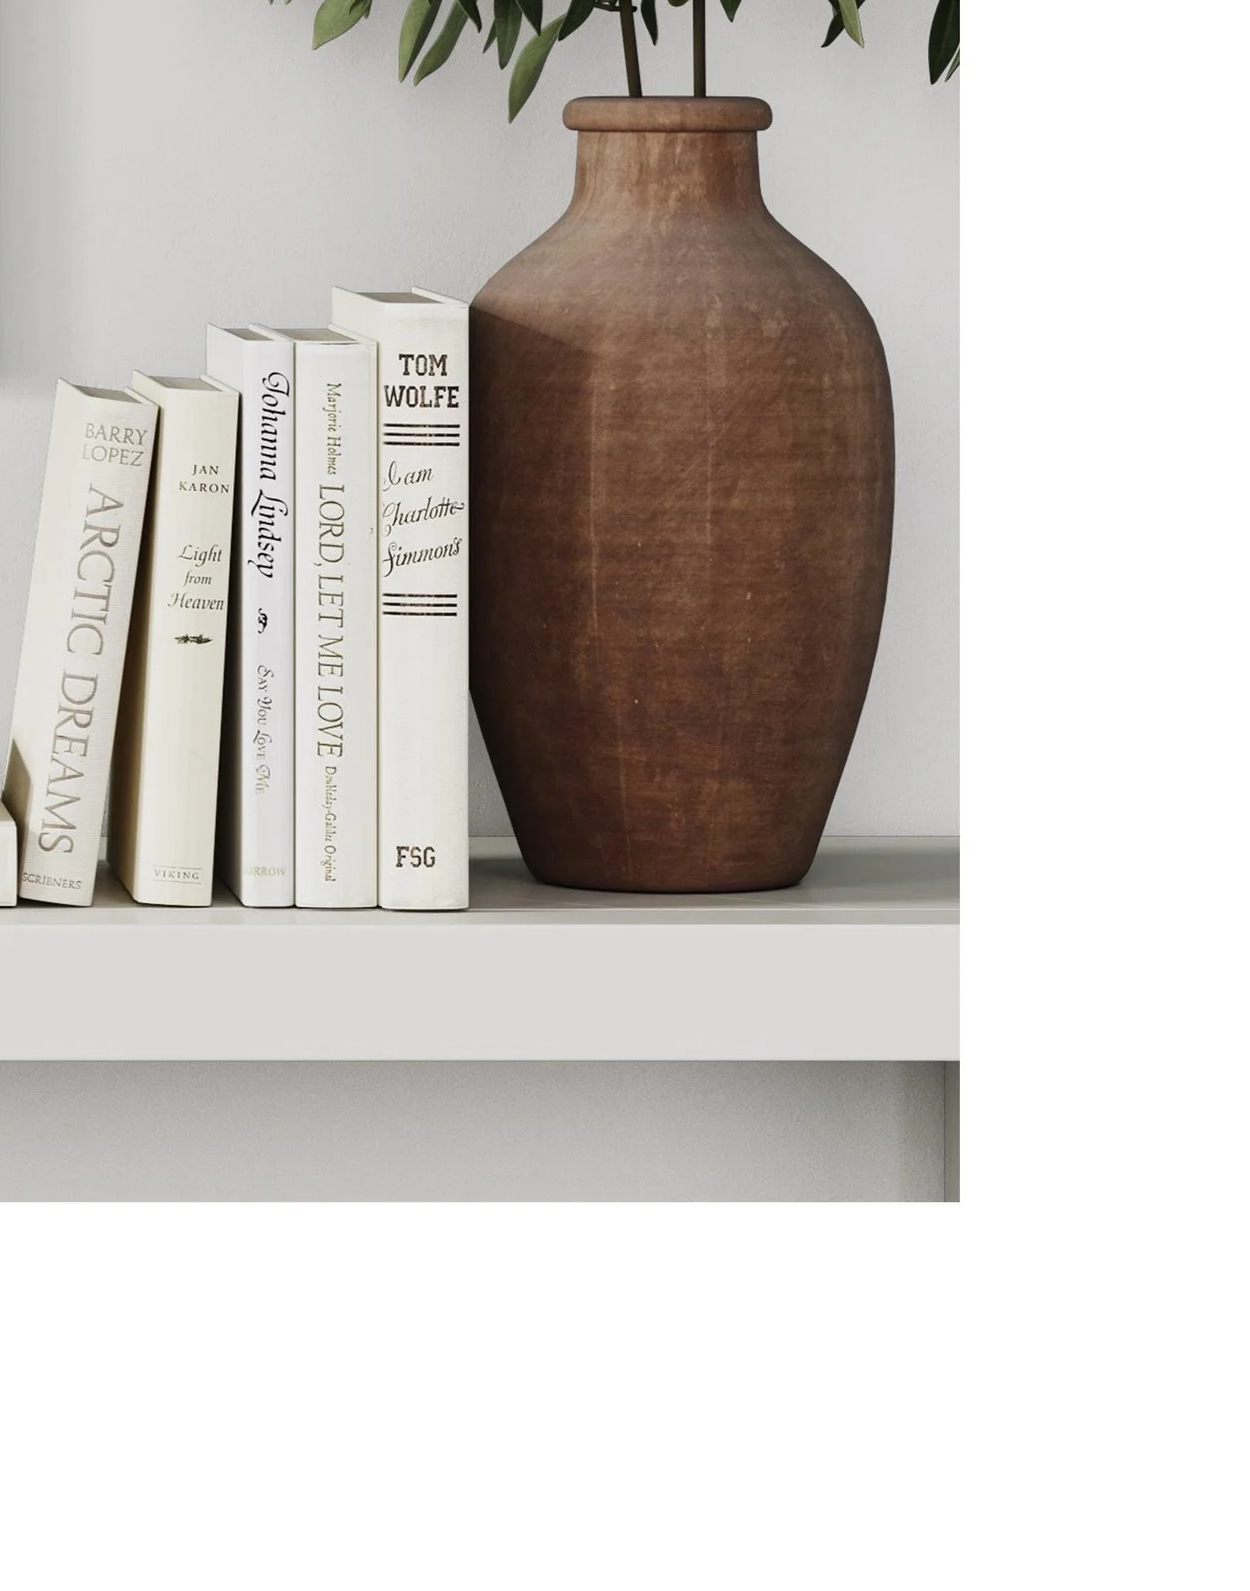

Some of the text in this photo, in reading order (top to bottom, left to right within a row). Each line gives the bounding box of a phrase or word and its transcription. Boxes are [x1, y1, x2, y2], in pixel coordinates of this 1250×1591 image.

[398, 353, 448, 377] TOM
[383, 384, 460, 408] WOLFE
[84, 422, 148, 445] BARRY
[322, 383, 342, 475] Marjorie Holmes
[82, 443, 144, 467] LOPEZ
[191, 464, 219, 476] JAN
[247, 371, 290, 578] Johanna Lindsey
[383, 460, 432, 491] I am
[178, 481, 230, 494] KARON
[382, 495, 465, 537] Charlotte
[177, 544, 223, 568] Light
[183, 569, 212, 587] from
[167, 592, 224, 611] Heaven
[313, 484, 345, 758] LORD, LET ME LOVE
[38, 482, 124, 854] ARCTIC DREAMS
[320, 844, 338, 882] Original
[396, 846, 436, 868] FSG
[21, 872, 82, 890] SCRIBNERS
[154, 869, 199, 880] VIKING
